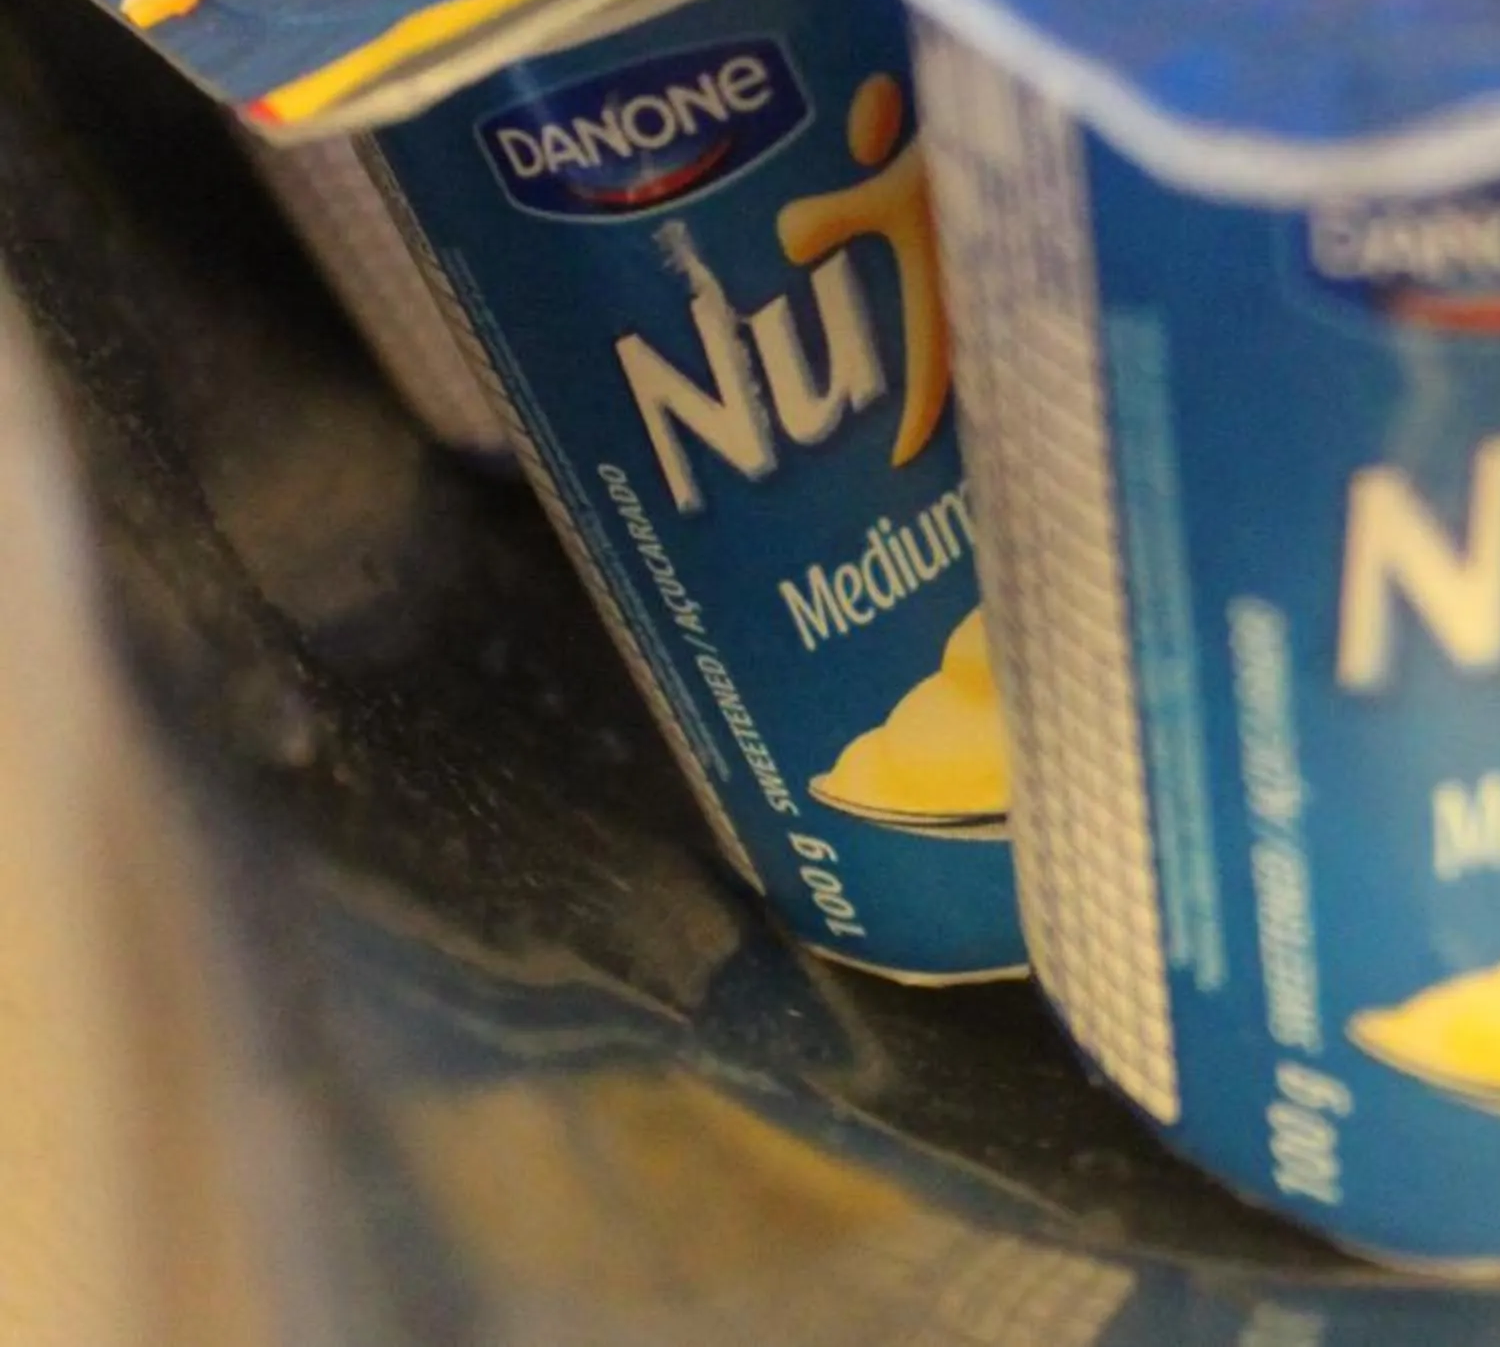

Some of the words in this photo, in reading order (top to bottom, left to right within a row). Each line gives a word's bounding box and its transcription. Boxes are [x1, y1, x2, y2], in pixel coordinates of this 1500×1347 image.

[496, 56, 774, 179] DANONE
[695, 654, 799, 816] SWEETENED
[788, 832, 838, 863] g
[802, 867, 866, 938] 100
[1274, 1059, 1355, 1119] g
[1265, 1101, 1343, 1207] 100
